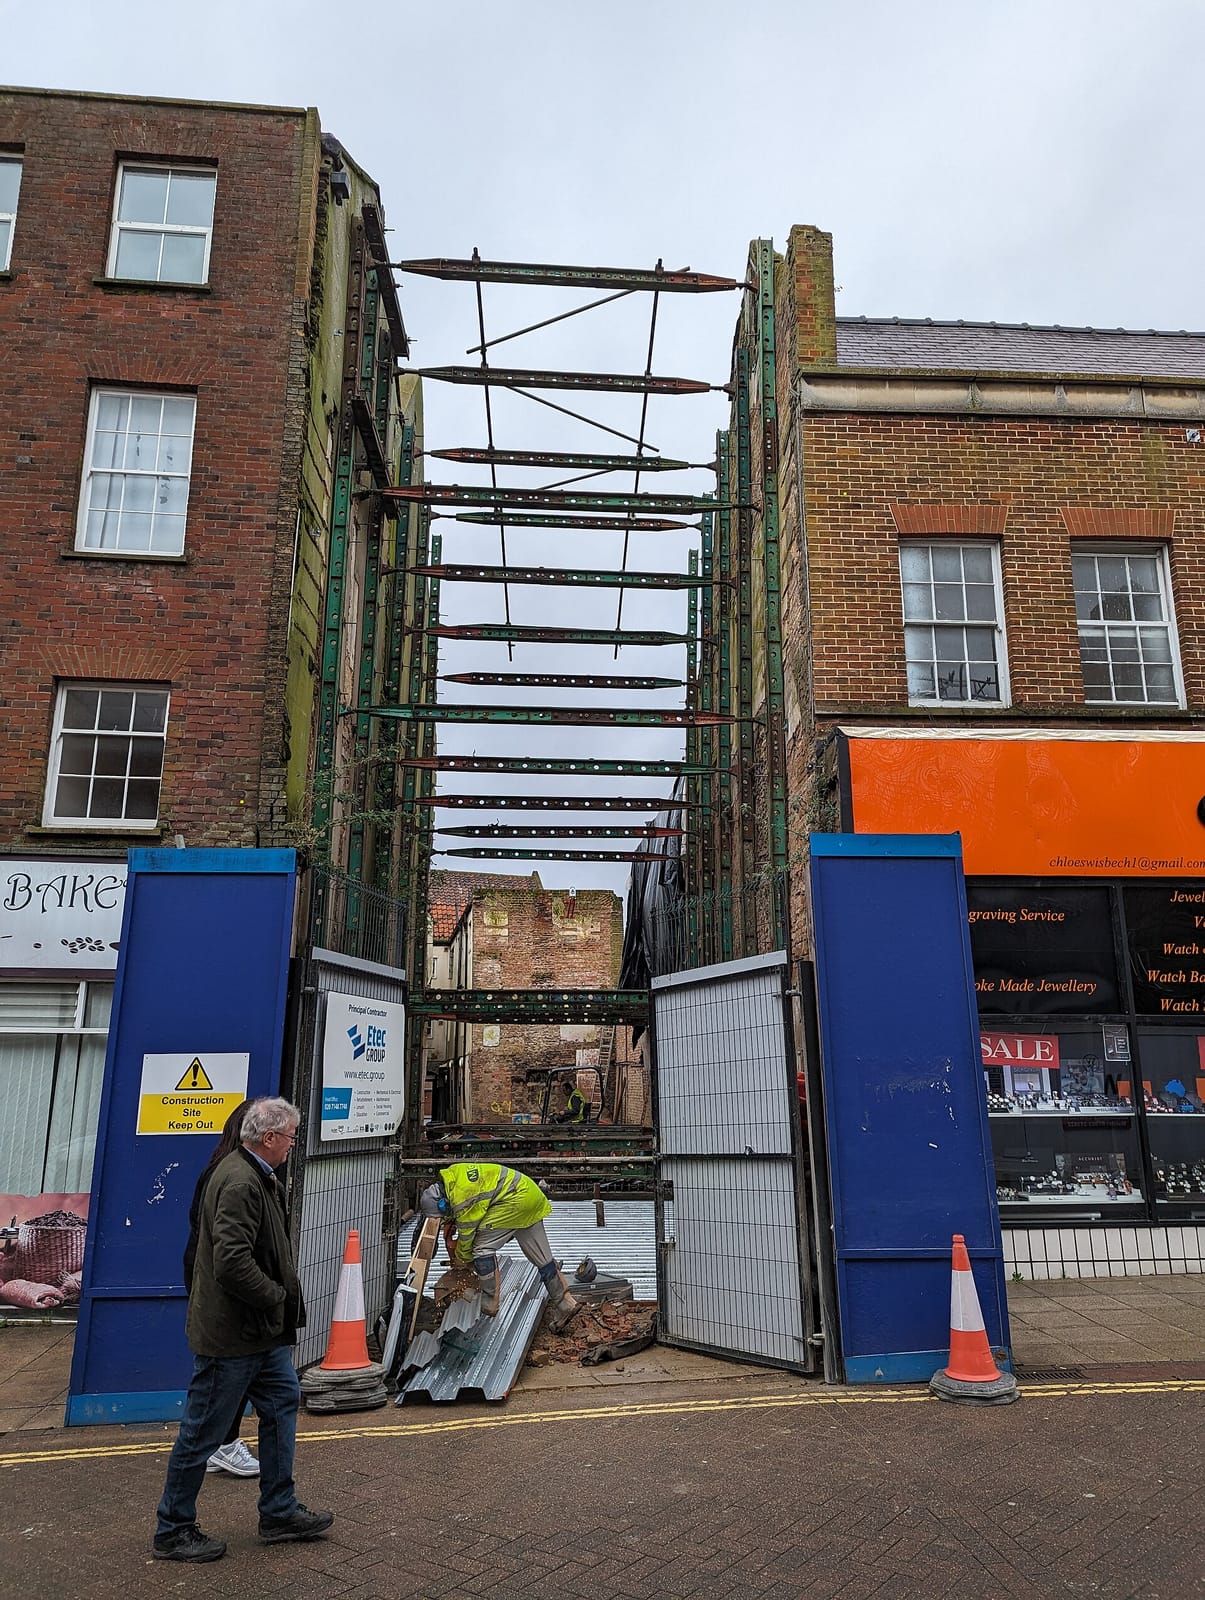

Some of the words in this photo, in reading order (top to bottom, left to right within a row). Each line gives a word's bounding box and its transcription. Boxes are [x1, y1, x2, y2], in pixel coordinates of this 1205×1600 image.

[4, 872, 127, 913] BAKE
[968, 908, 1016, 924] graving
[1020, 908, 1065, 921] Service
[1163, 943, 1199, 955] Watch
[1147, 970, 1186, 983] Watch
[974, 979, 995, 992] oke
[998, 979, 1034, 992] Made
[1036, 979, 1097, 995] Jewellery
[348, 1004, 366, 1015] Principal
[366, 1007, 387, 1017] Contractor
[1160, 999, 1200, 1012] Watch
[367, 1025, 386, 1047] Etec
[366, 1048, 386, 1062] GROUP
[980, 1036, 1054, 1061] SALE
[344, 1070, 385, 1082] www.etec.group
[161, 1095, 224, 1105] Construction
[182, 1108, 201, 1117] Site
[168, 1121, 193, 1131] Keep
[195, 1120, 213, 1129] Out
